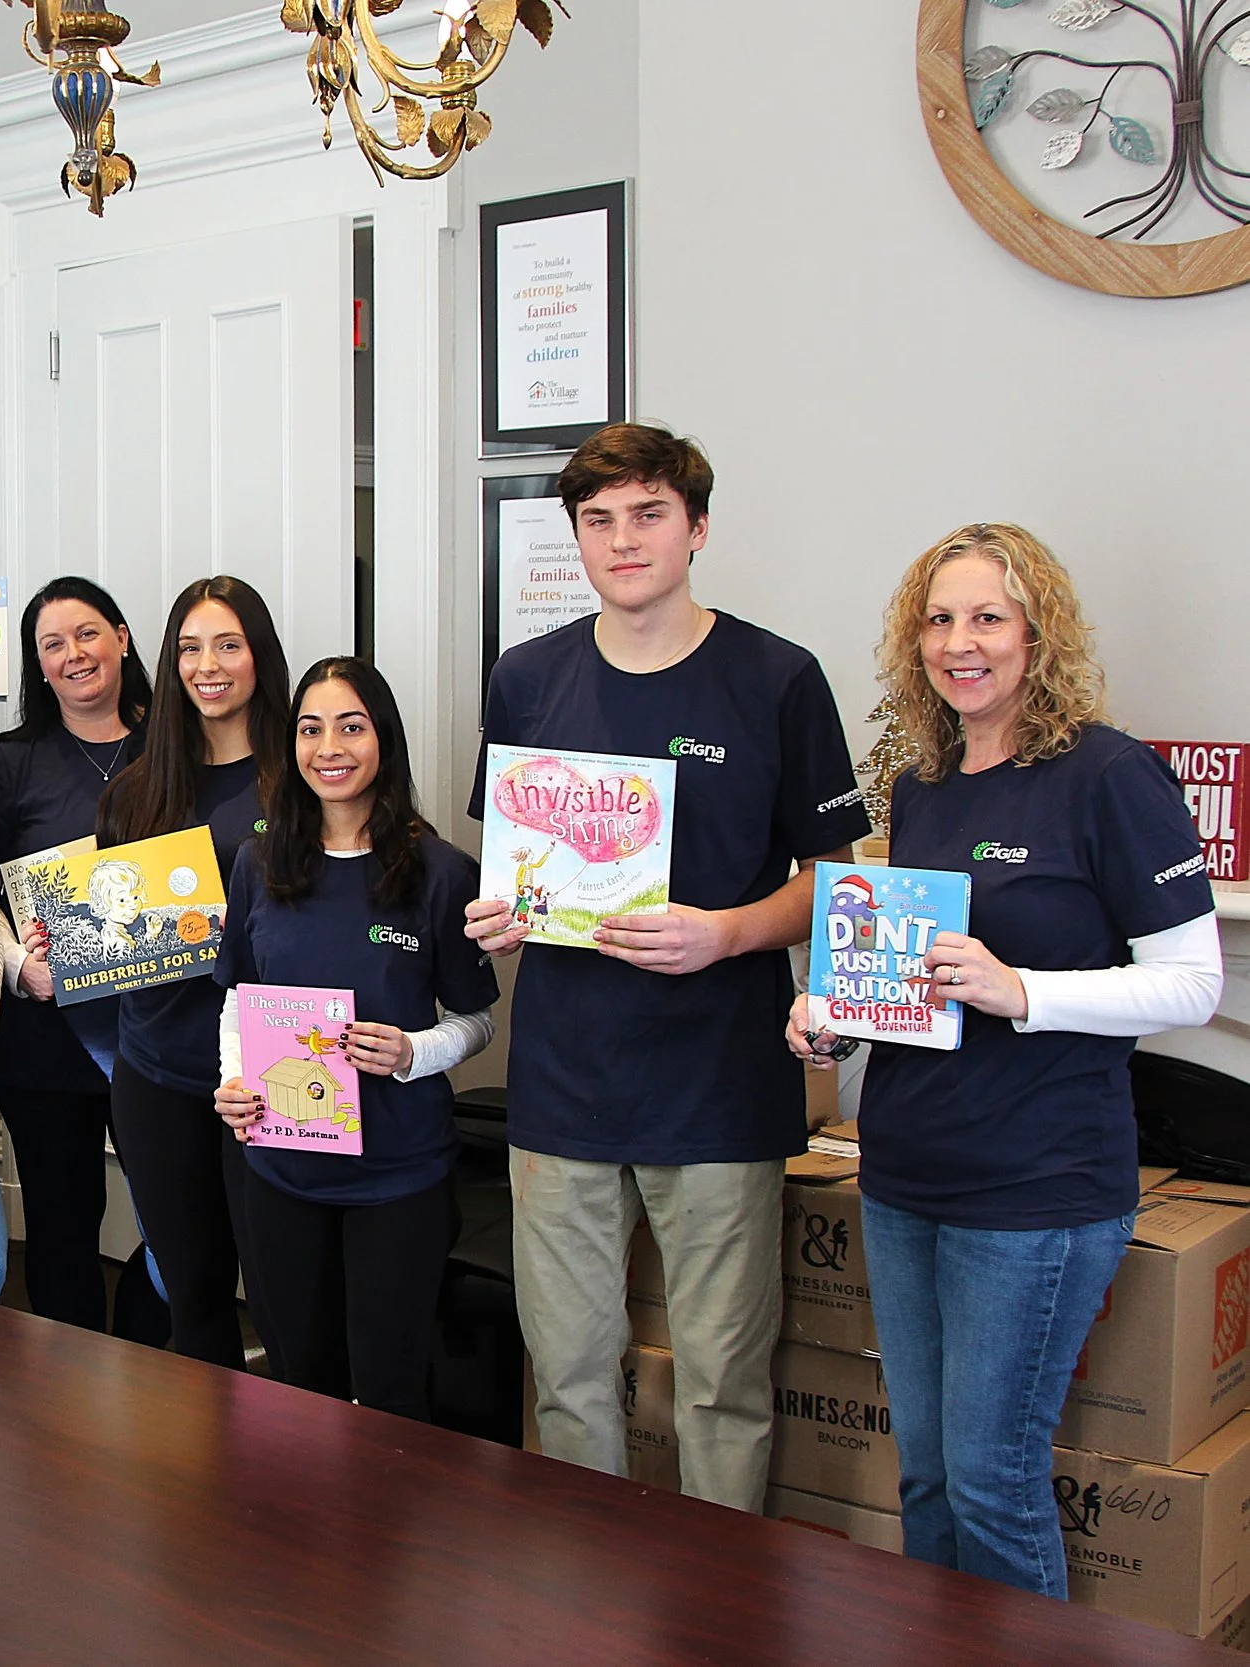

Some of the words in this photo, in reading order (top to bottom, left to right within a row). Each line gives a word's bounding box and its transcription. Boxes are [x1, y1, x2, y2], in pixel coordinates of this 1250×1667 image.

[534, 260, 543, 269] To
[545, 256, 565, 268] build
[531, 269, 574, 282] community
[513, 289, 521, 299] of
[566, 281, 593, 293] healthy
[527, 301, 578, 318] families
[518, 323, 534, 332] who
[536, 320, 562, 332] protect
[544, 332, 559, 342] and
[560, 330, 588, 340] nurture
[526, 346, 579, 363] children
[550, 386, 579, 399] Village
[530, 542, 564, 551] Construir
[528, 553, 570, 563] comunidad
[530, 568, 580, 582] familias
[520, 587, 562, 601] fuertes
[516, 607, 530, 616] que
[531, 606, 561, 616] protegen
[569, 606, 594, 615] acogen
[533, 624, 544, 633] los
[1170, 746, 1240, 782] MOST
[516, 769, 539, 785] The
[508, 778, 642, 814] Invisible
[550, 812, 638, 851] String
[578, 881, 605, 891] Patrice
[182, 922, 194, 935] 75
[62, 962, 158, 992] BLUEBERRIES
[163, 951, 194, 970] FOR
[199, 946, 220, 962] SA
[830, 951, 887, 974] PUSH
[894, 955, 932, 978] THE
[114, 978, 142, 991] ROBERT
[834, 975, 930, 1006] BUTTON!
[247, 995, 276, 1010] The
[280, 998, 316, 1012] Best
[829, 1000, 936, 1023] Christmas
[264, 1014, 300, 1028] Nest
[875, 1022, 933, 1032] ADVENTURE
[261, 1125, 272, 1135] by
[298, 1128, 339, 1140] Eastman
[818, 1431, 870, 1452] BN.COM
[1104, 1485, 1171, 1522] 6610
